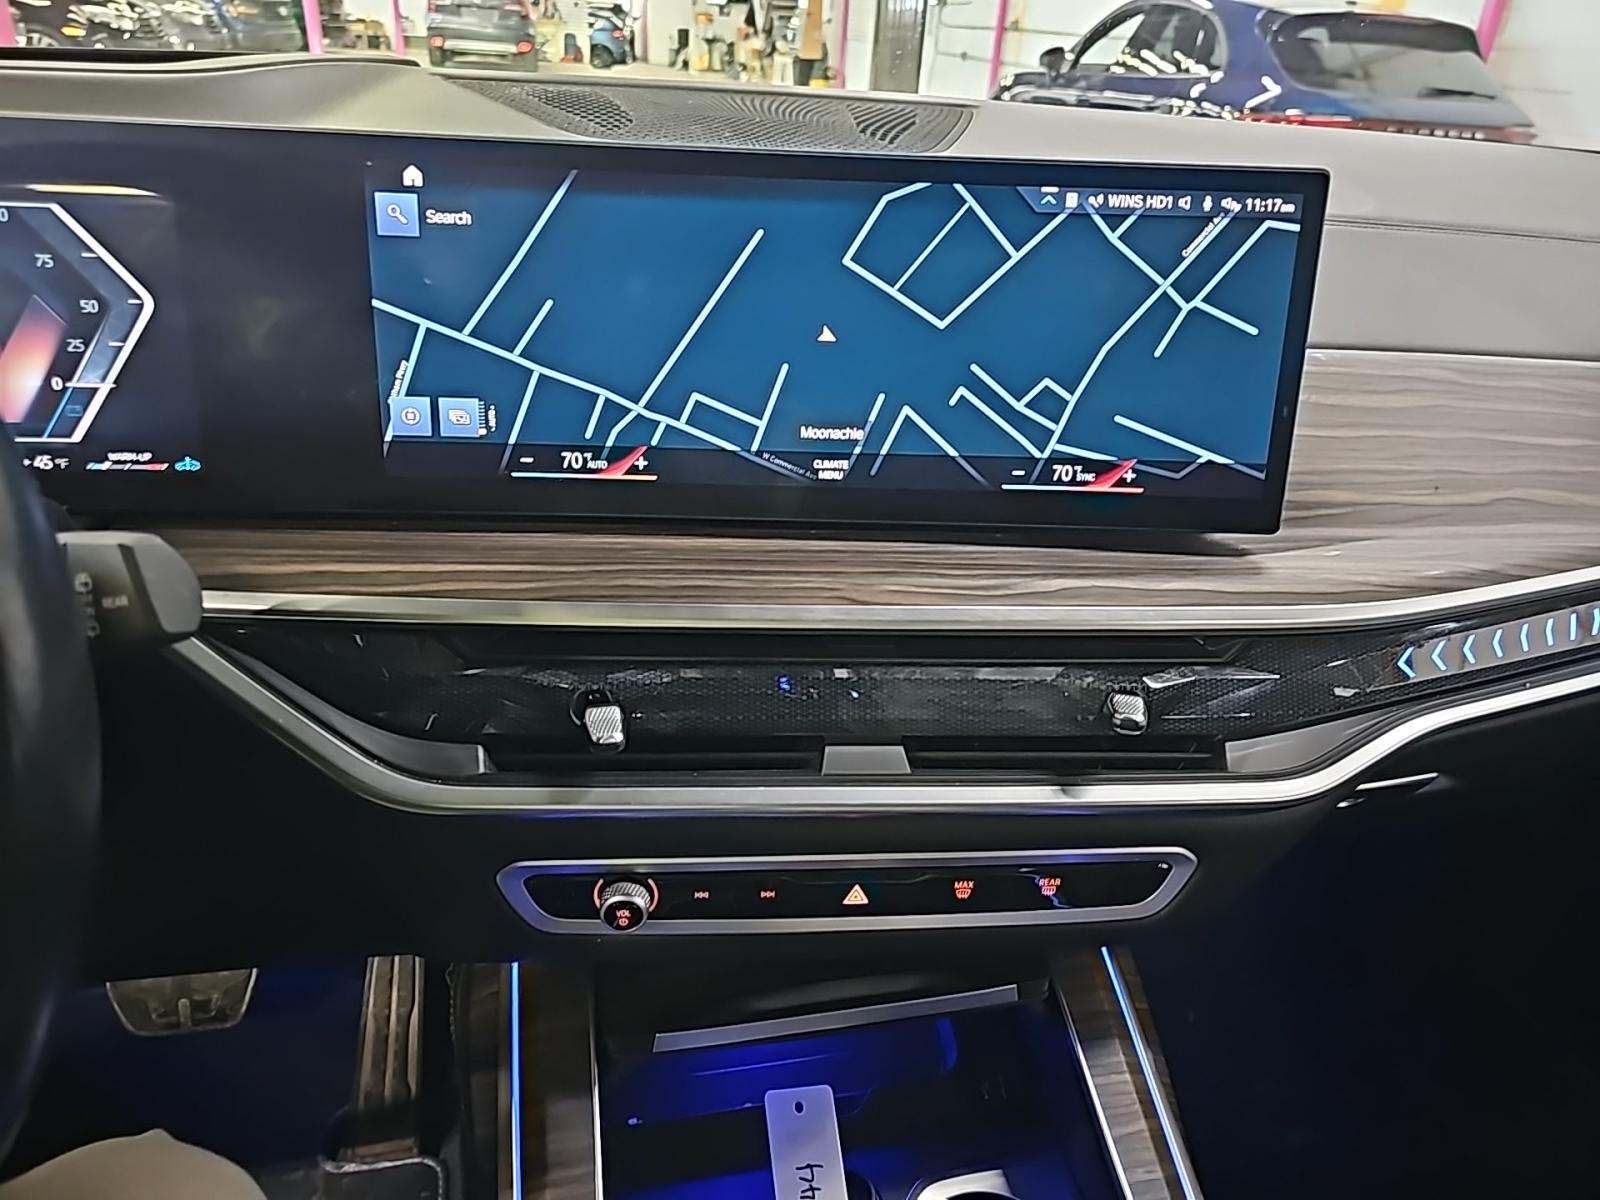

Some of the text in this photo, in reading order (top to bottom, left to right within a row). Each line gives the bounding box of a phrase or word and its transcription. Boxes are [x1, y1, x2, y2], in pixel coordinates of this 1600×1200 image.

[1108, 194, 1173, 209] WINS HD1
[425, 209, 472, 226] Search
[34, 253, 54, 268] 75
[79, 300, 99, 313] 50
[66, 339, 85, 352] 25
[51, 376, 63, 391] 0
[800, 426, 865, 440] Moonachie
[587, 460, 608, 469] AUTO
[813, 459, 849, 470] CLIMATE
[818, 470, 844, 480] MENU
[954, 880, 974, 889] MAX
[1039, 878, 1061, 887] REAR
[616, 909, 631, 918] VOL
